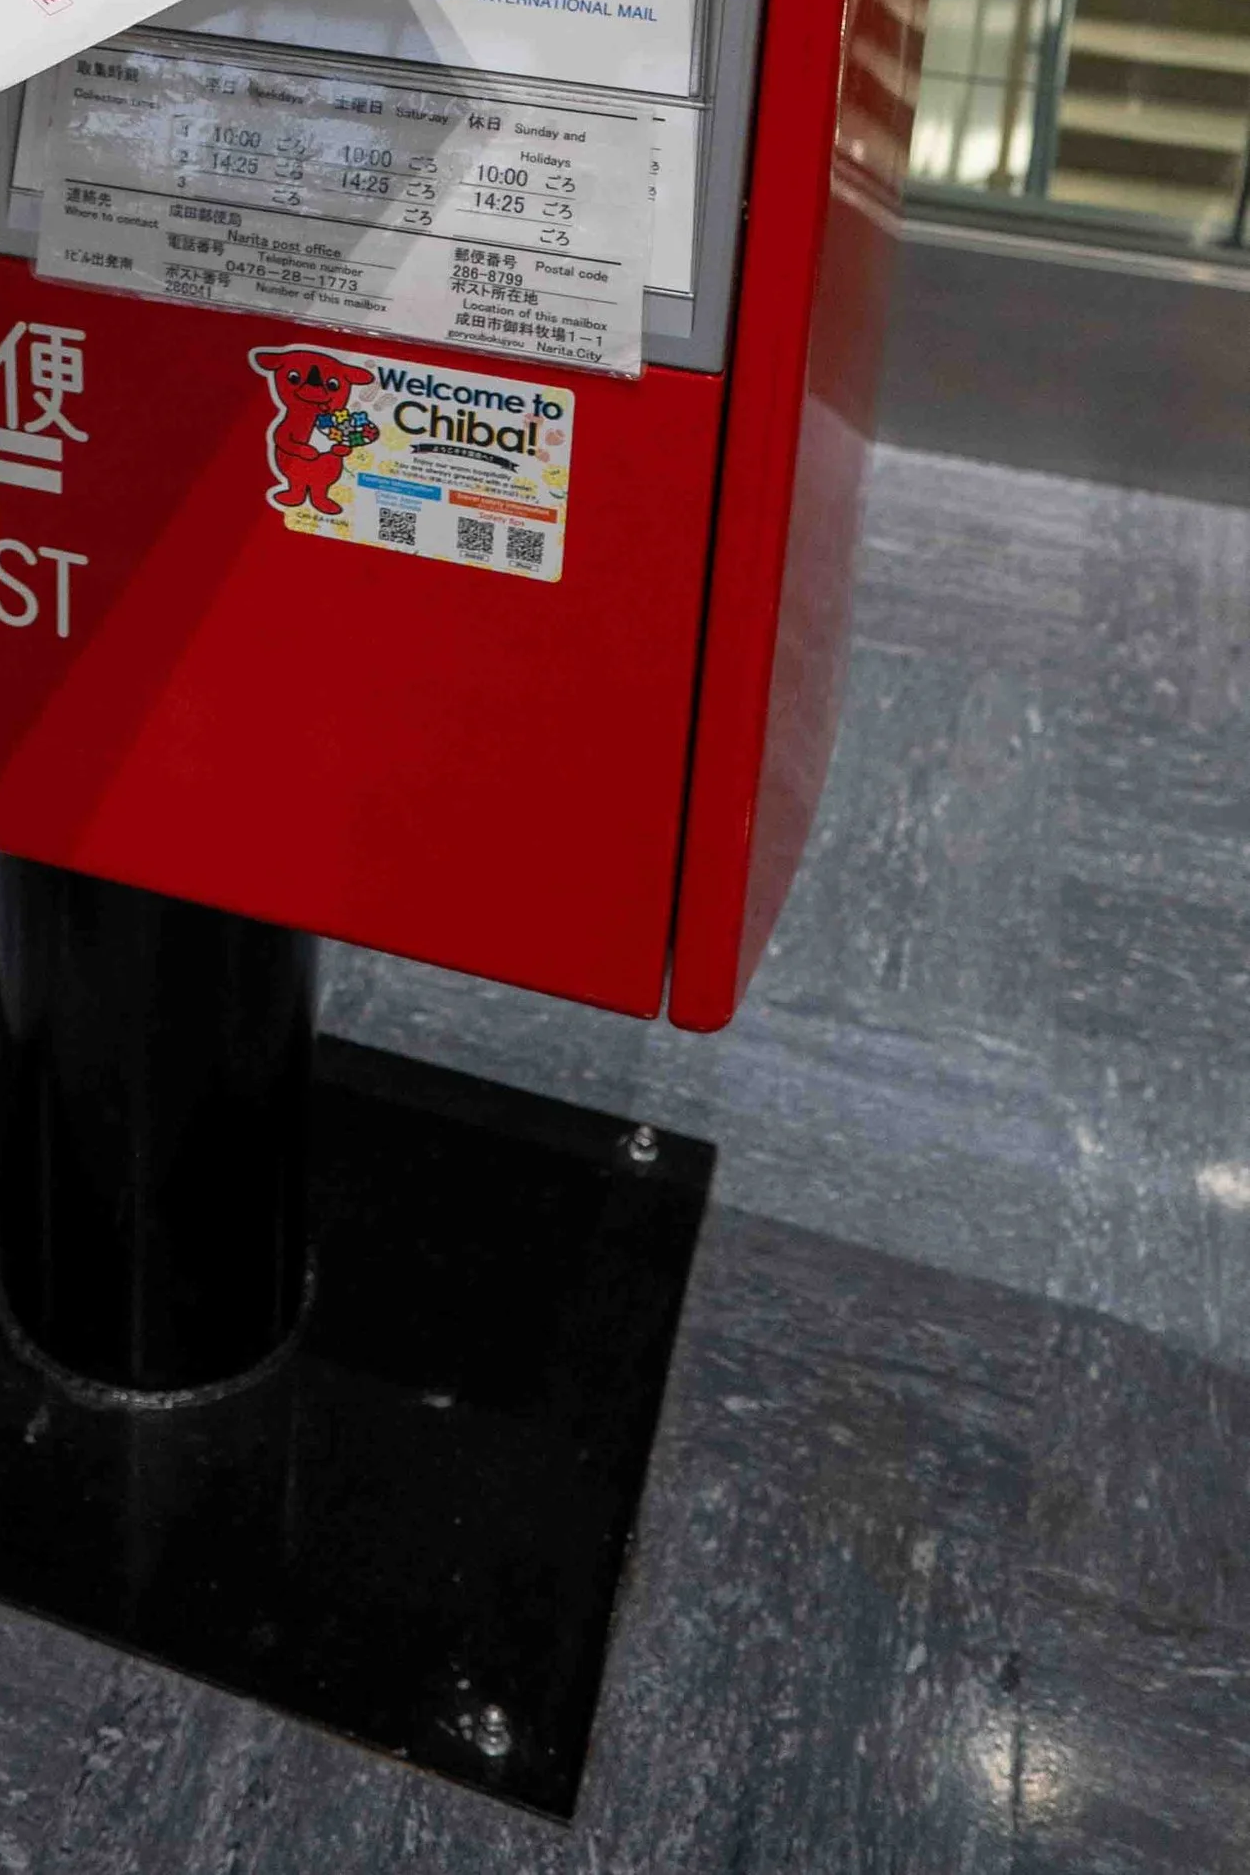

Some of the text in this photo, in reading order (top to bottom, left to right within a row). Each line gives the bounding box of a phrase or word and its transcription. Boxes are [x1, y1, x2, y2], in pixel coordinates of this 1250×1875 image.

[617, 4, 658, 23] MAIL
[468, 113, 502, 131] 休日
[514, 123, 586, 143] Sunday and
[214, 127, 262, 148] 10:00
[212, 153, 259, 174] 14:25
[343, 145, 438, 174] 10:00 ごろ
[520, 151, 572, 168] Holidays
[341, 171, 436, 200] 14:25 ごろ
[477, 164, 577, 193] 10:00 ごろ
[272, 189, 301, 206] ごろ
[474, 191, 574, 220] 14:25 ごろ
[101, 212, 113, 222] to
[403, 208, 433, 226] ごろ
[167, 233, 225, 256] 電話番号
[227, 229, 342, 259] Narita post office
[539, 228, 571, 247] ごろ
[257, 251, 364, 278] Telephone number
[454, 247, 518, 270] 郵便番号
[165, 265, 232, 288] ポスト番号
[452, 264, 524, 287] 286-8799
[535, 260, 609, 283] Postal code
[255, 281, 388, 313] Number of this mailbox
[451, 280, 539, 307] ポスト所在地
[463, 298, 608, 331] Location of this mailbox
[536, 341, 574, 358] Narita
[576, 347, 603, 363] City
[378, 366, 564, 420] Welcome to
[394, 400, 539, 457] Chiba!
